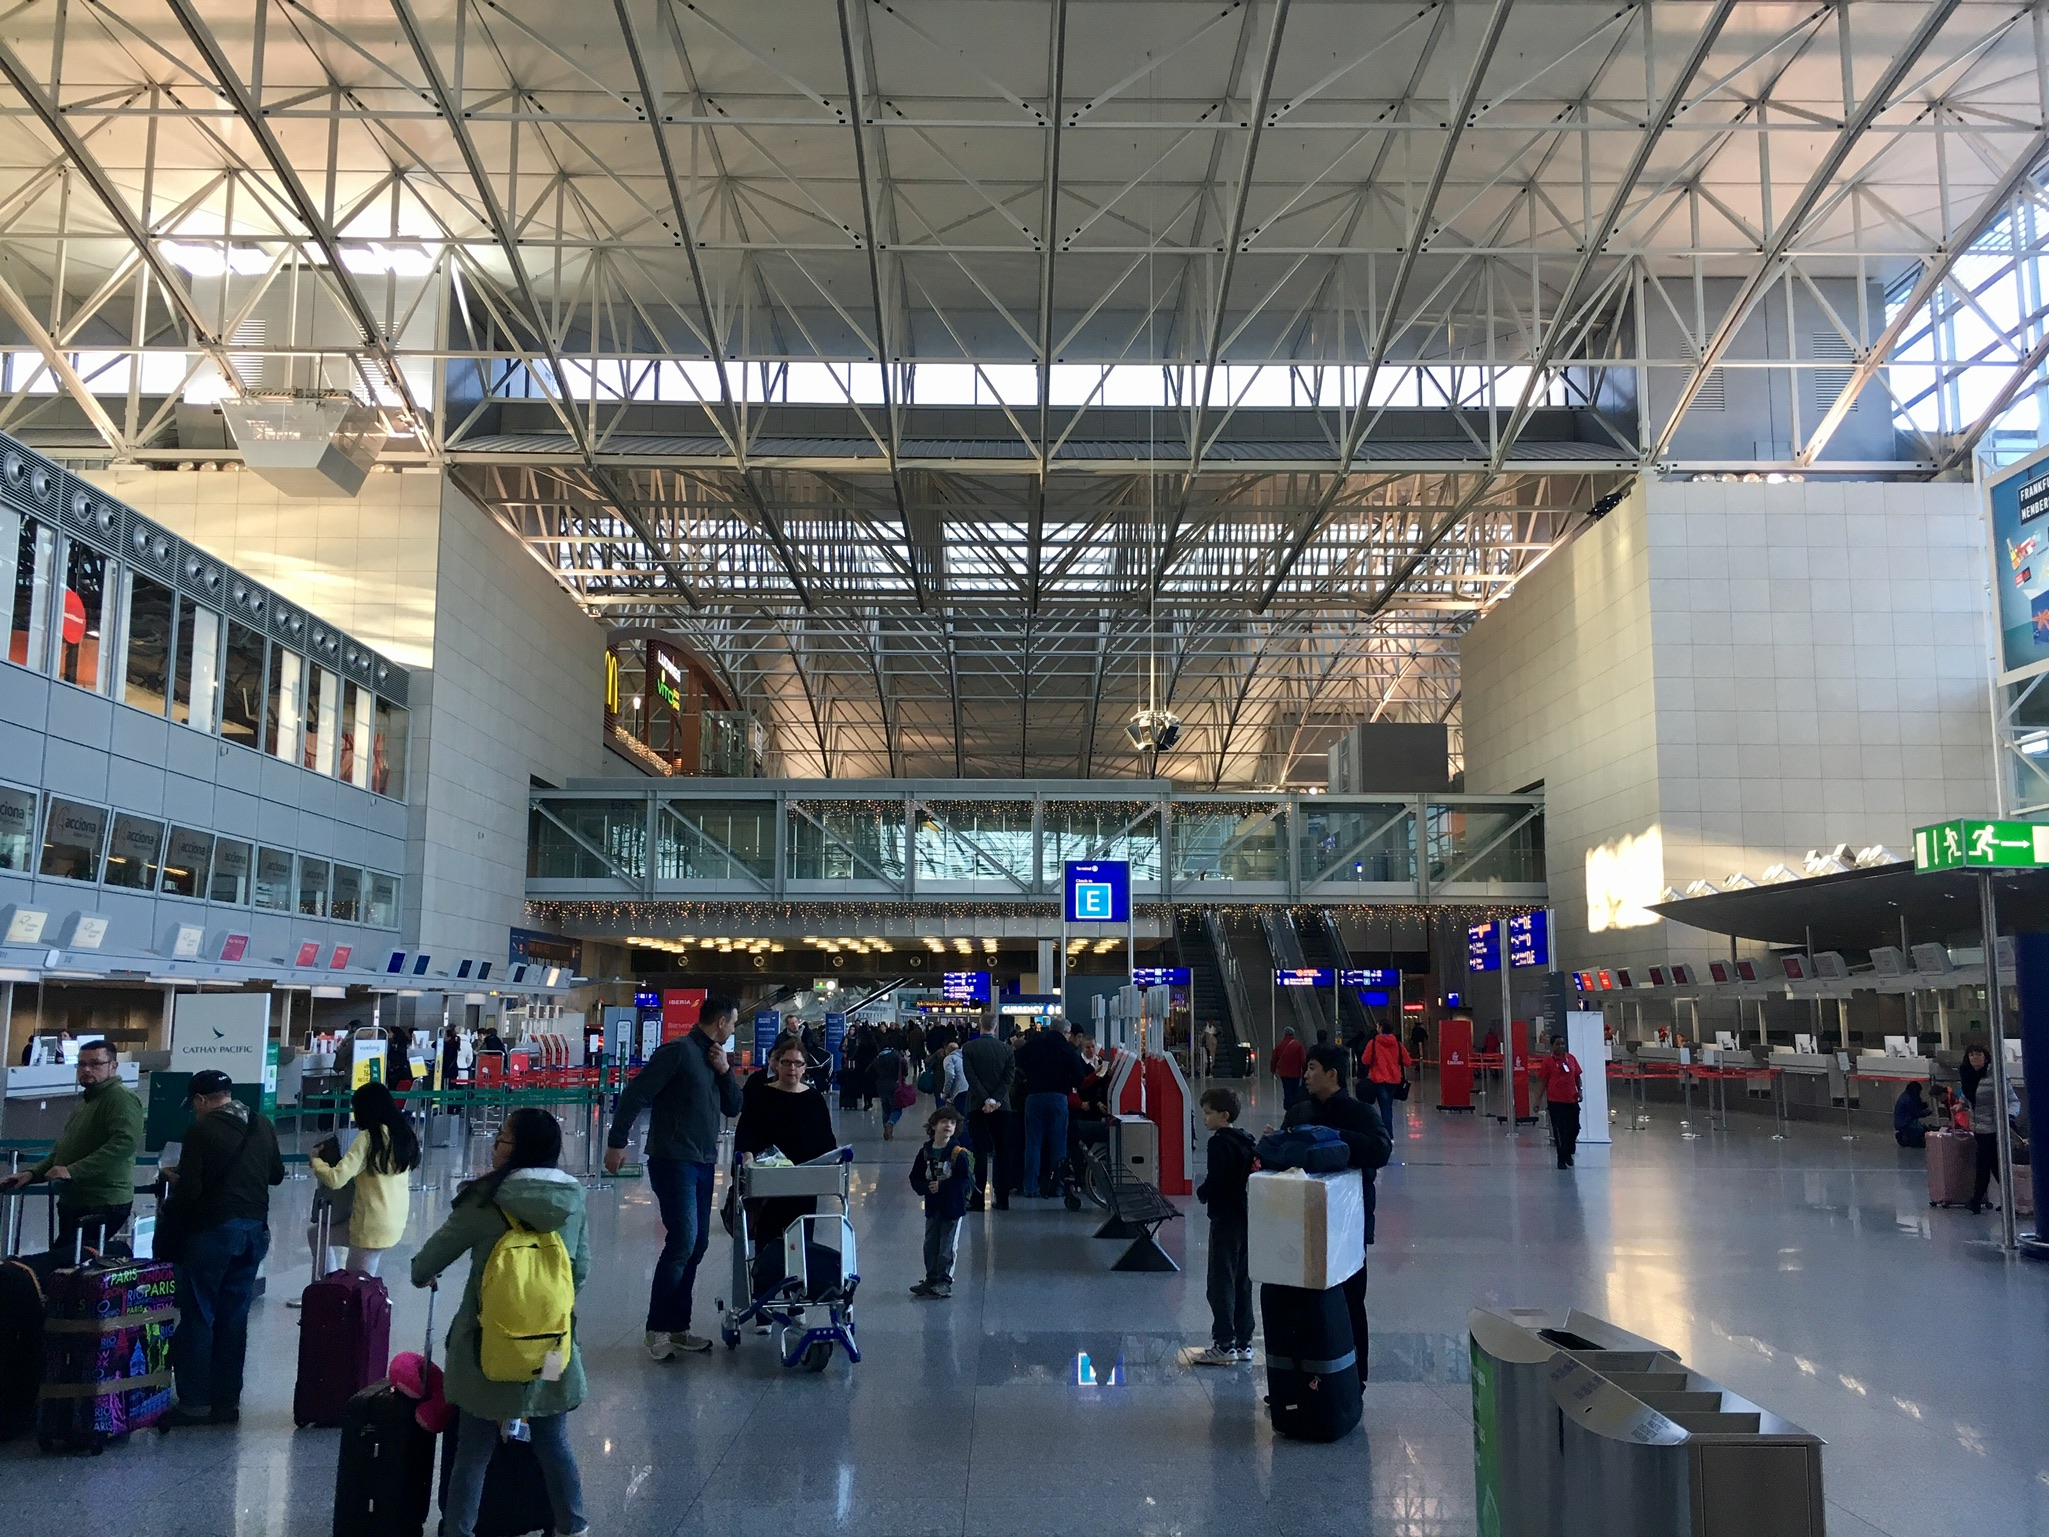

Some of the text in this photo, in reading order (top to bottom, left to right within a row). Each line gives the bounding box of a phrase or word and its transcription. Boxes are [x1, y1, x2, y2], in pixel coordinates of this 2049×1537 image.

[65, 816, 96, 834] acciona
[126, 829, 154, 845] acciona
[181, 840, 206, 856] acciona
[1086, 890, 1101, 912] E
[1002, 1005, 1044, 1014] CURRENCY
[182, 1045, 254, 1054] CATHAY PACIFIC
[359, 1043, 380, 1052] vueling
[110, 1268, 138, 1286] PARIS
[143, 1280, 176, 1298] PARIS
[94, 1406, 111, 1417] RIO
[93, 1420, 113, 1431] ARIS
